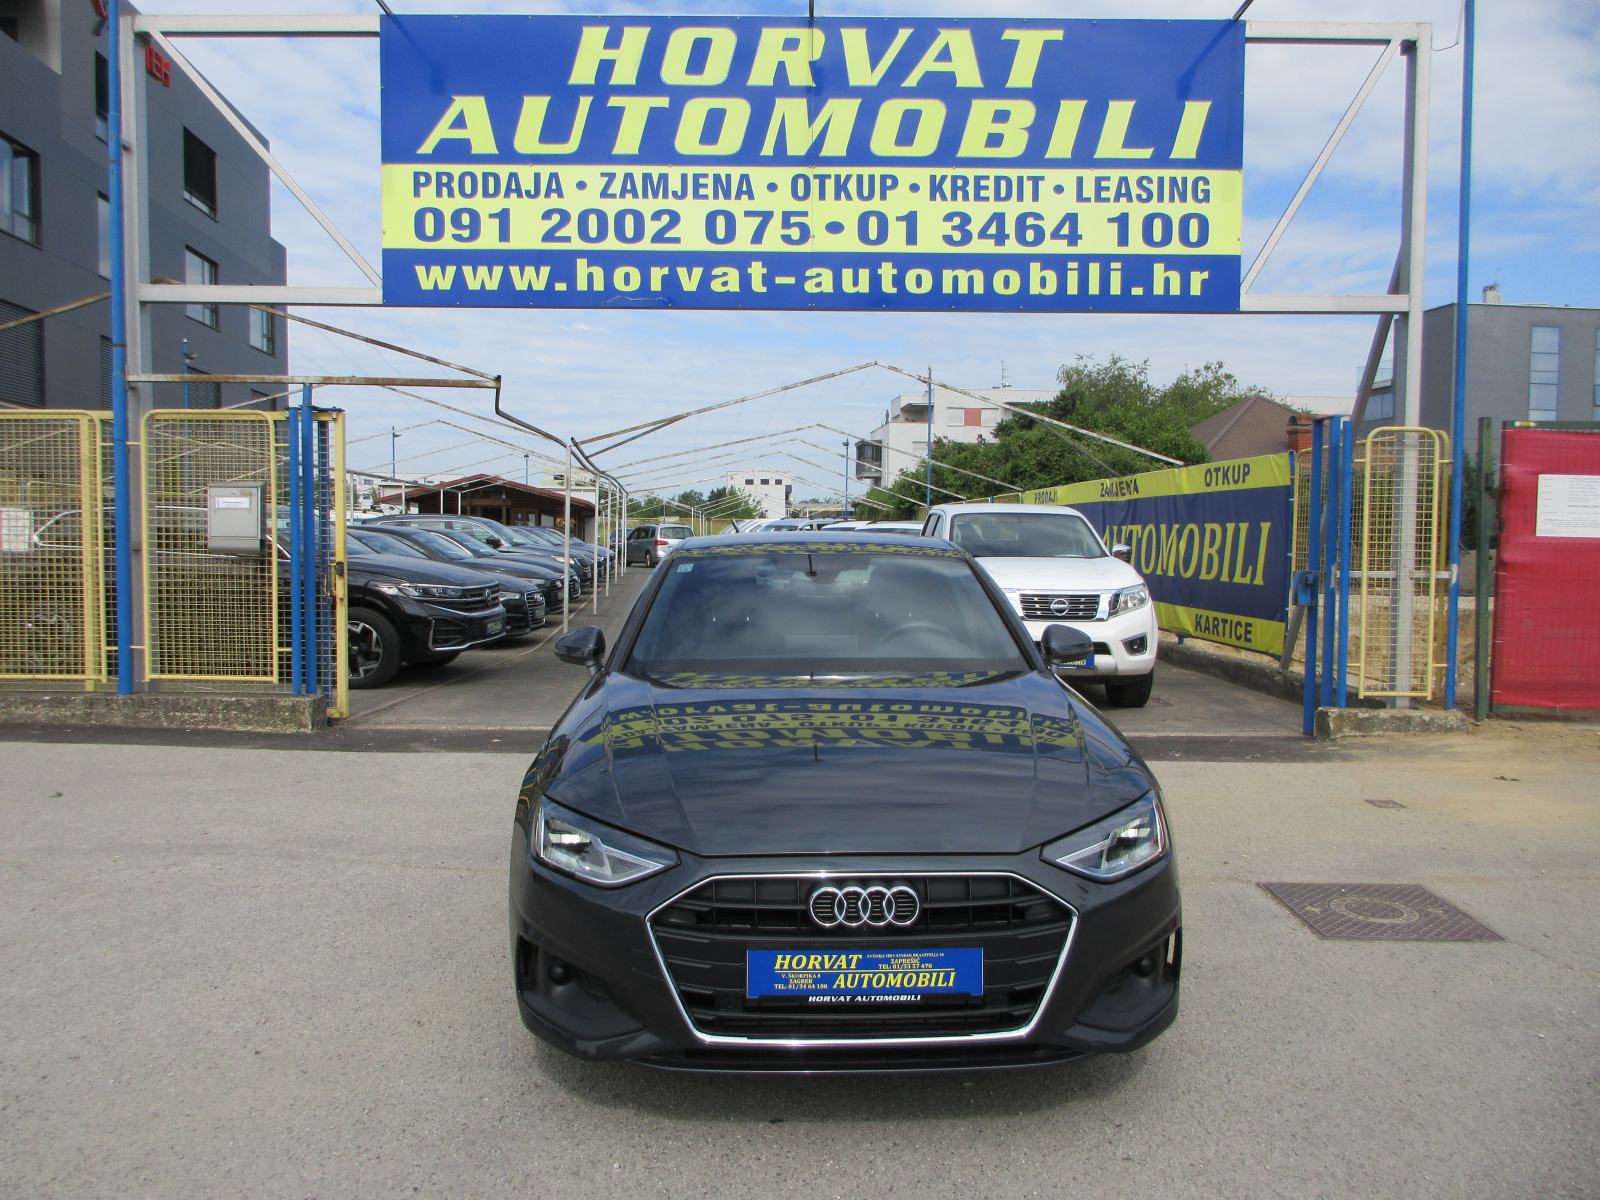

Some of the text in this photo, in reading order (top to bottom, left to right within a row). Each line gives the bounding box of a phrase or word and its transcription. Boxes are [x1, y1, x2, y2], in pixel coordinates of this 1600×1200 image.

[568, 26, 1064, 88] HORVAT
[416, 95, 1212, 159] AUTOMOBILI
[412, 171, 1211, 204] PRODAJA ZAMJENA OTKUP KREDIT LEASING
[413, 207, 1210, 248] 091 2002 075 01 3464 100
[414, 258, 1209, 296] www.horvat-automobili.hr
[1204, 463, 1251, 487] OTKUP
[1194, 613, 1253, 643] KARTICE
[774, 954, 863, 970] HORVAT
[832, 971, 956, 989] AUTOMOBILI
[808, 994, 921, 1003] HORVAT AUTOMOBILI
